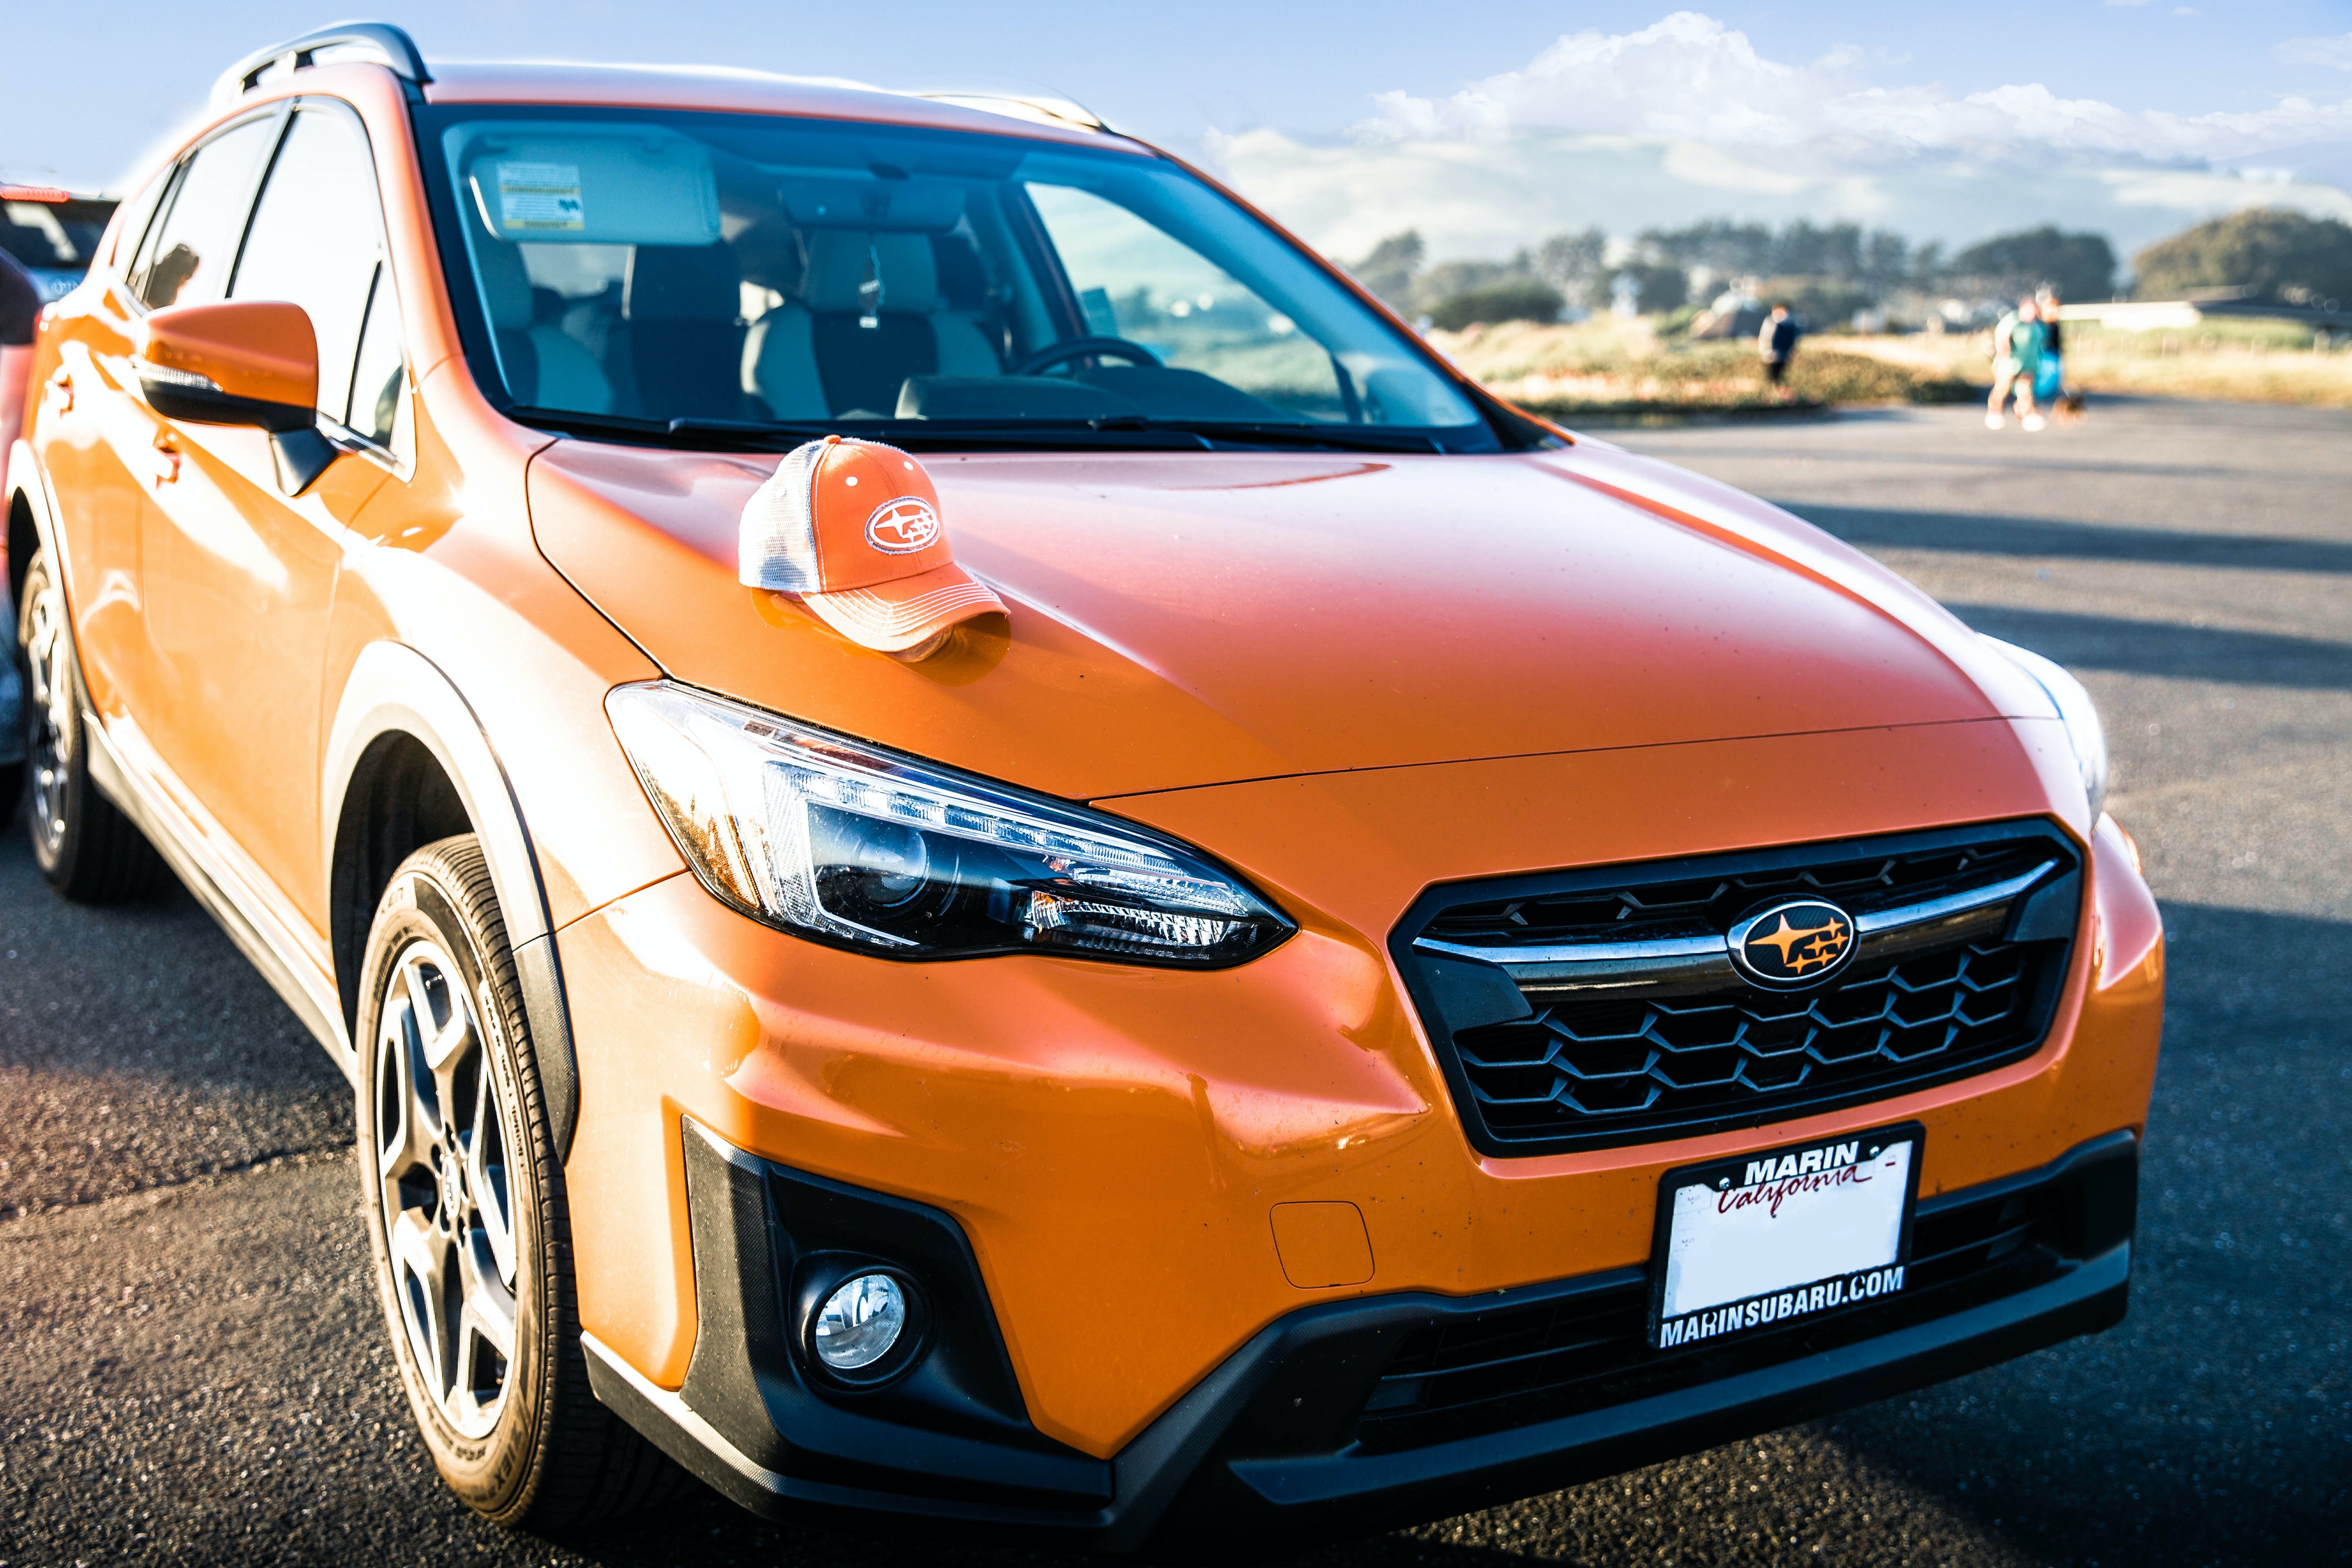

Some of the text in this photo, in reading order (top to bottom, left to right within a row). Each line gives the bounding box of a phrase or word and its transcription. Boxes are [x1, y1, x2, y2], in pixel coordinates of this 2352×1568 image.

[1744, 1141, 1860, 1186] MARIN
[1718, 1164, 1873, 1216] California
[1660, 1266, 1905, 1349] MARINSUBARU.COM
